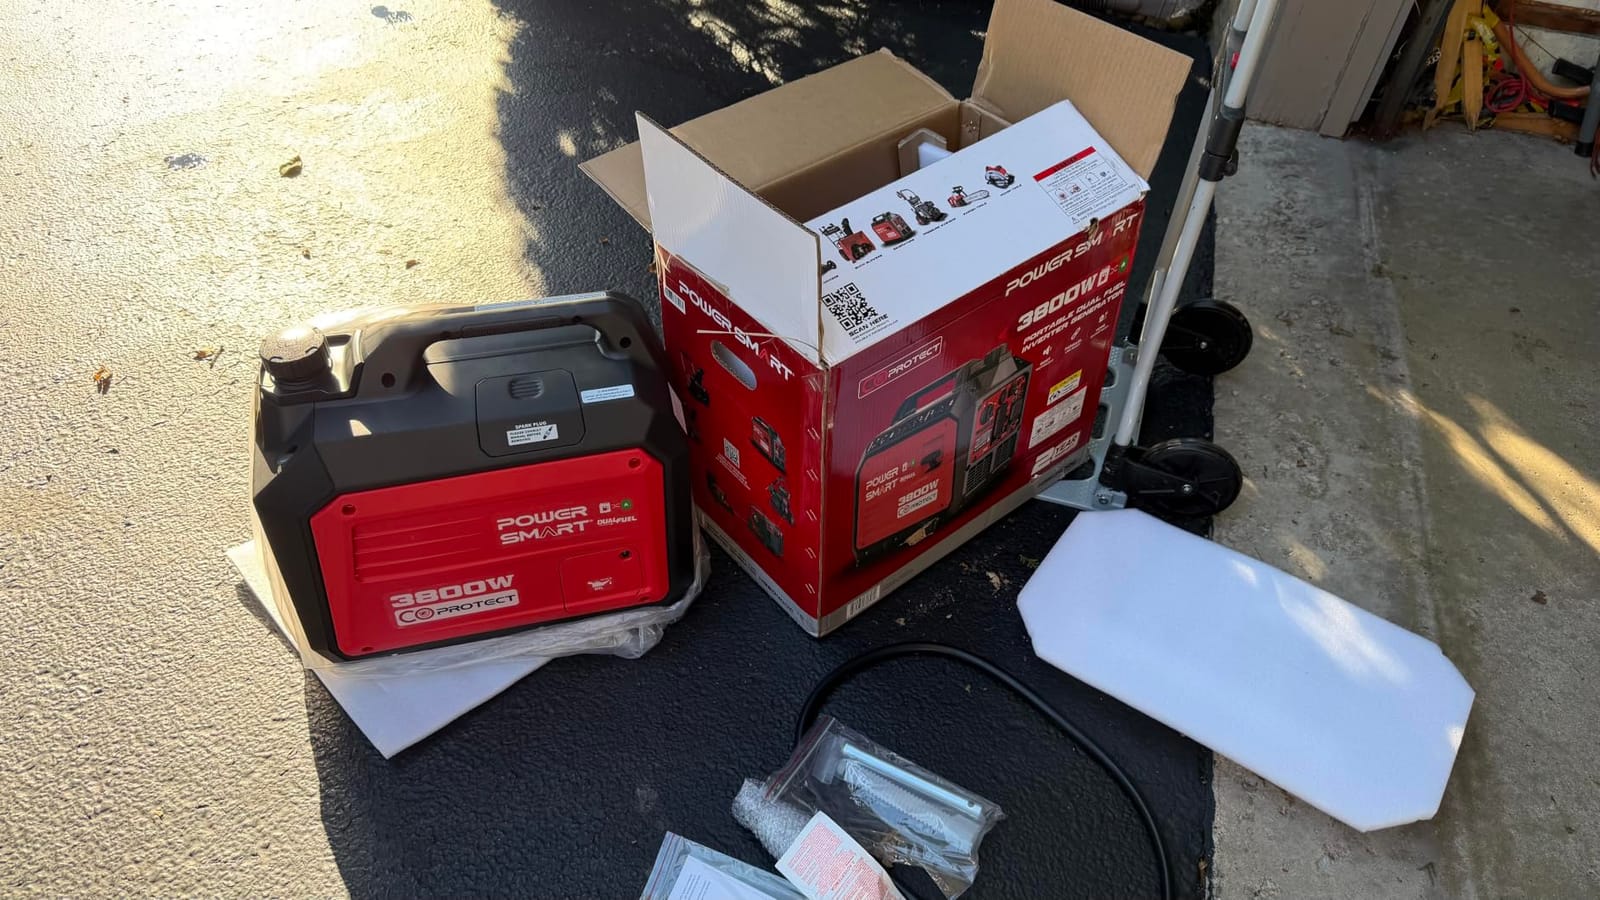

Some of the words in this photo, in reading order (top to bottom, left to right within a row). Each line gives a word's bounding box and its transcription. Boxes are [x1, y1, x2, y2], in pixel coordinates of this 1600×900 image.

[1005, 249, 1073, 297] POWER
[1017, 273, 1098, 332] 3800W
[1023, 310, 1075, 345] PORTABLE
[1076, 295, 1101, 314] DUAL
[1103, 280, 1126, 298] FUEL
[678, 280, 733, 333] POWER
[734, 326, 793, 381] SMART
[849, 324, 869, 337] SCAN
[869, 313, 889, 326] HERE
[1021, 320, 1069, 354] INVERTER
[1070, 288, 1125, 325] GENERATOR
[888, 342, 941, 378] PROTECT
[865, 466, 899, 490] POWER
[865, 478, 898, 502] SMART
[496, 505, 588, 530] POWER
[500, 520, 590, 545] SMART
[390, 574, 515, 608] 3800W
[436, 594, 516, 616] PROTECT
